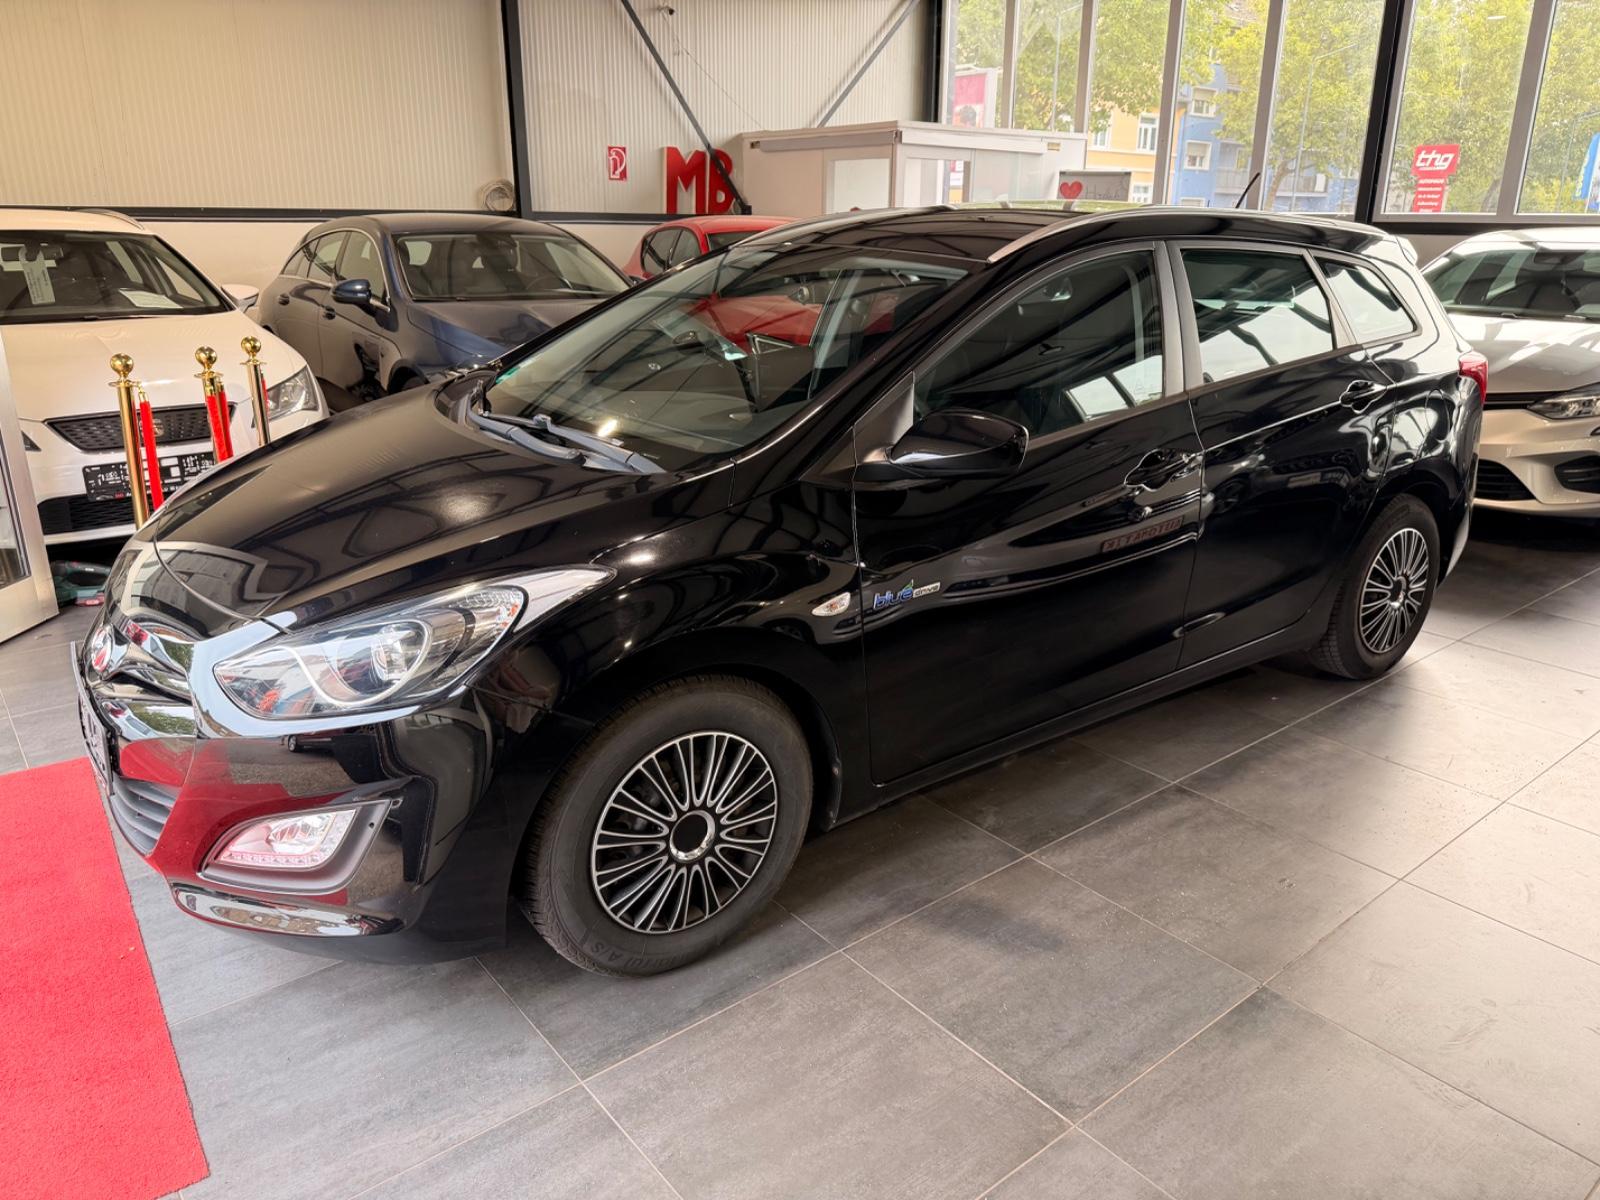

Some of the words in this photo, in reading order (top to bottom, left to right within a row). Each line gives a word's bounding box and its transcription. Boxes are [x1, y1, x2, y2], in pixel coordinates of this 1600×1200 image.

[1415, 150, 1455, 170] thg
[664, 146, 735, 215] MB
[873, 586, 913, 609] blue
